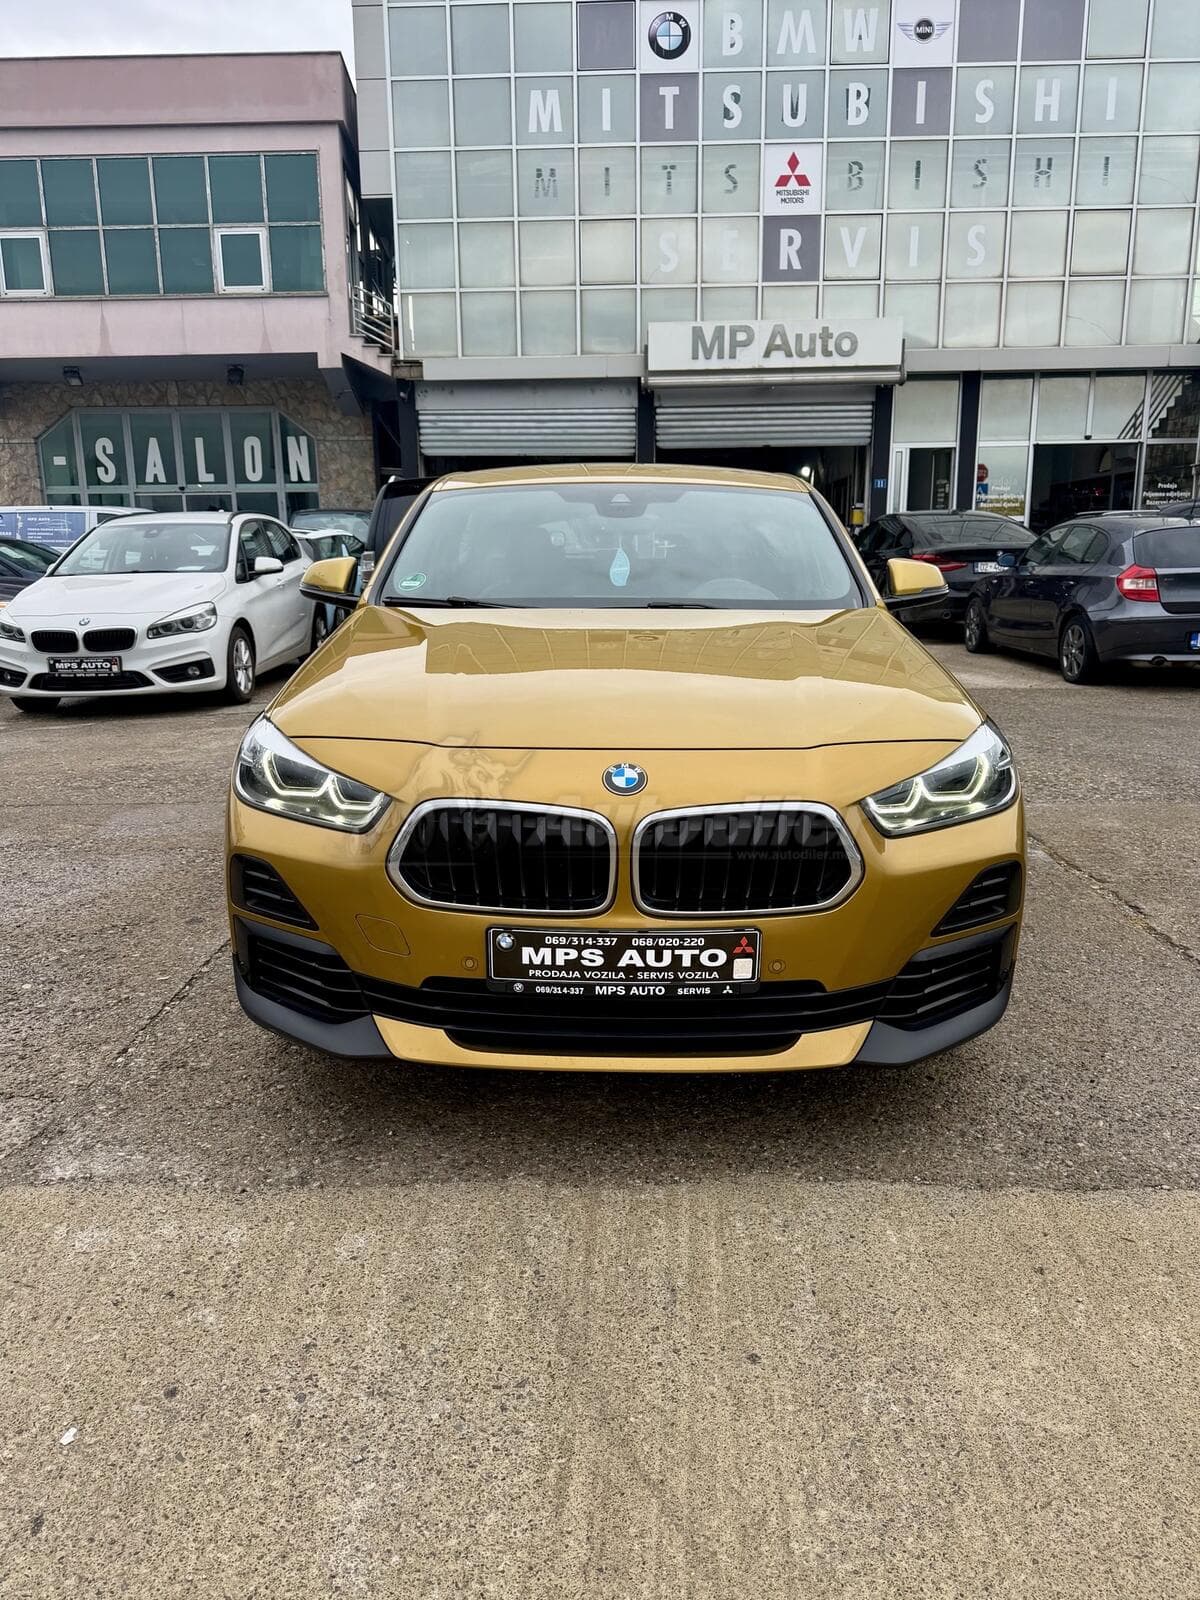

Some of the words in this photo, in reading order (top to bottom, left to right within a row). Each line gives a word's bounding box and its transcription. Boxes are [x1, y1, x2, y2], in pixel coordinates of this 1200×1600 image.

[722, 8, 879, 56] BMW
[916, 25, 934, 33] MINI
[528, 76, 1118, 133] MITSUBISHI
[659, 225, 987, 273] SERVIS
[691, 324, 755, 360] MP
[763, 323, 859, 358] Auto
[94, 435, 312, 484] SALON
[544, 936, 618, 946] 069/314-337
[631, 937, 705, 947] 068/020-220
[521, 946, 605, 967] MPS
[617, 948, 728, 968] AUTO
[528, 969, 581, 979] PRODAJA
[584, 971, 626, 979] VOZILA
[637, 971, 675, 980] SERVIS
[677, 971, 720, 980] VOZILA
[535, 985, 585, 995] 069/314-337
[595, 985, 626, 996] MPS
[629, 985, 666, 996] AUTO
[677, 986, 711, 995] SERVIS
